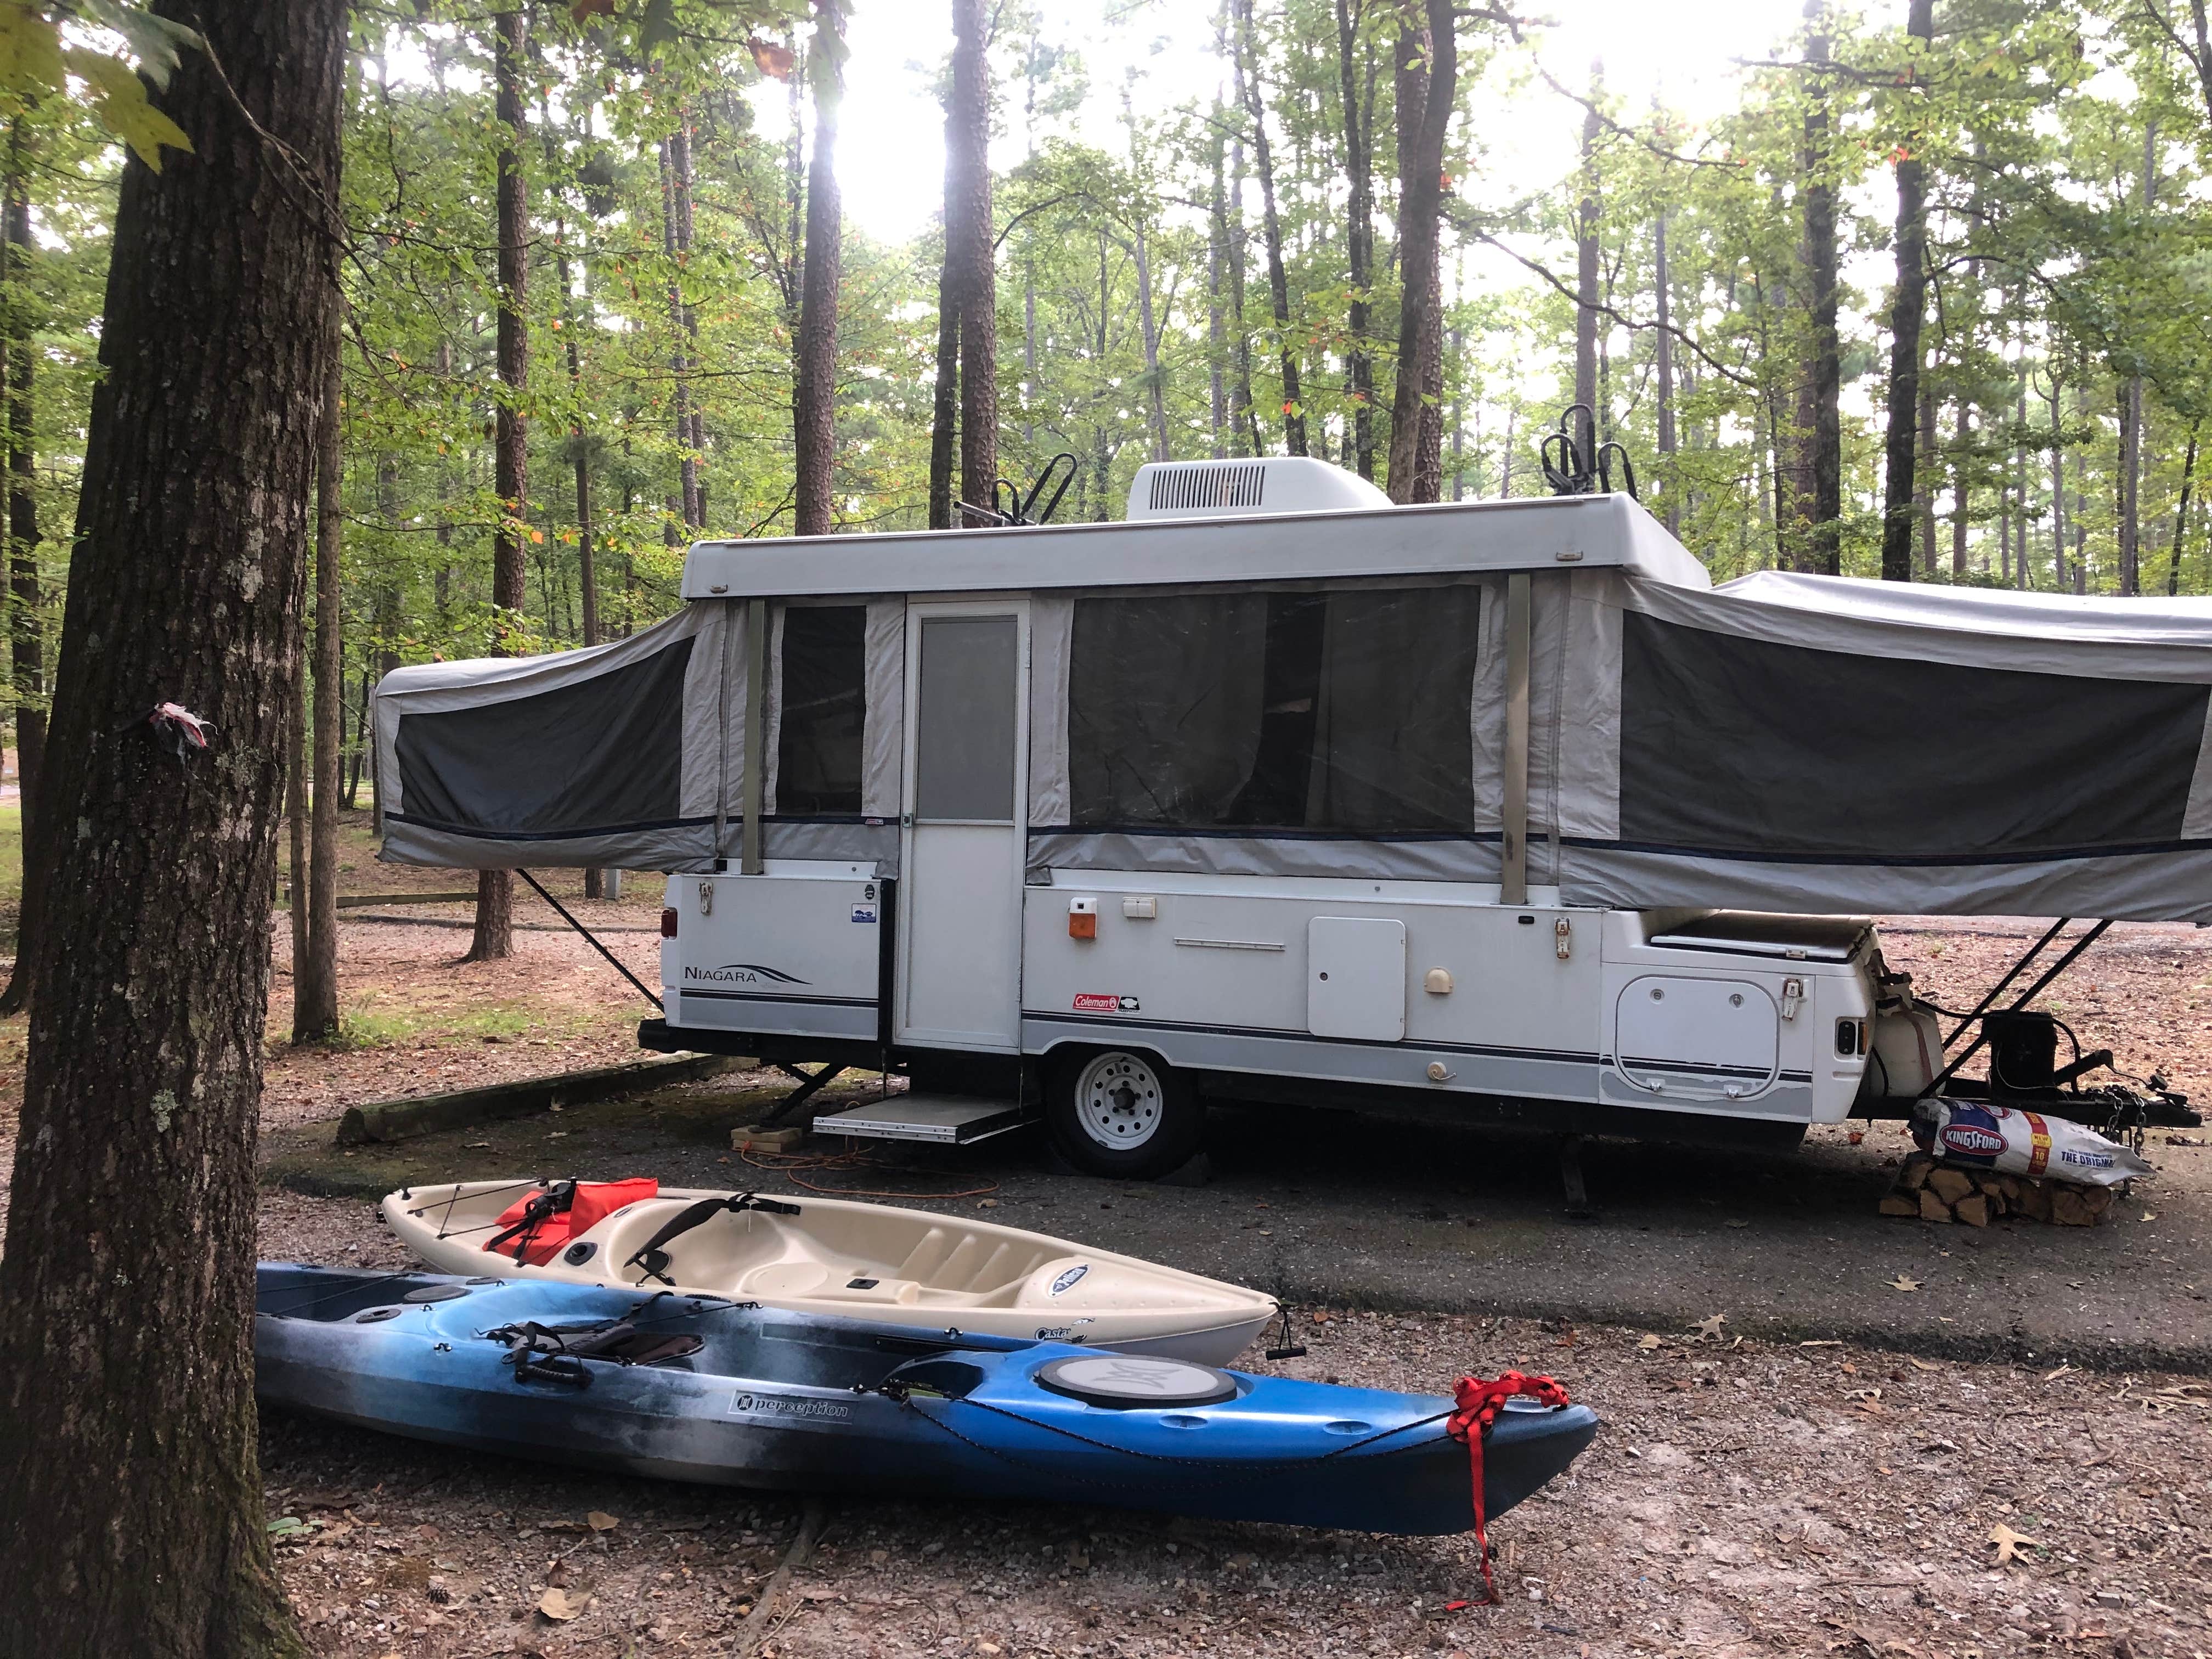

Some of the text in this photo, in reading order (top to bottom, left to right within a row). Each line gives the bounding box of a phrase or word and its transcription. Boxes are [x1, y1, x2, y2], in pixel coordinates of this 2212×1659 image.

[685, 967, 757, 983] NIAGARA
[1075, 995, 1109, 1007] Coleman
[1945, 1130, 2001, 1150] KINGSFORD
[2035, 1152, 2045, 1161] 10
[2061, 1151, 2078, 1164] THE
[1057, 1268, 1086, 1286] Pelican
[755, 1400, 848, 1417] perception
